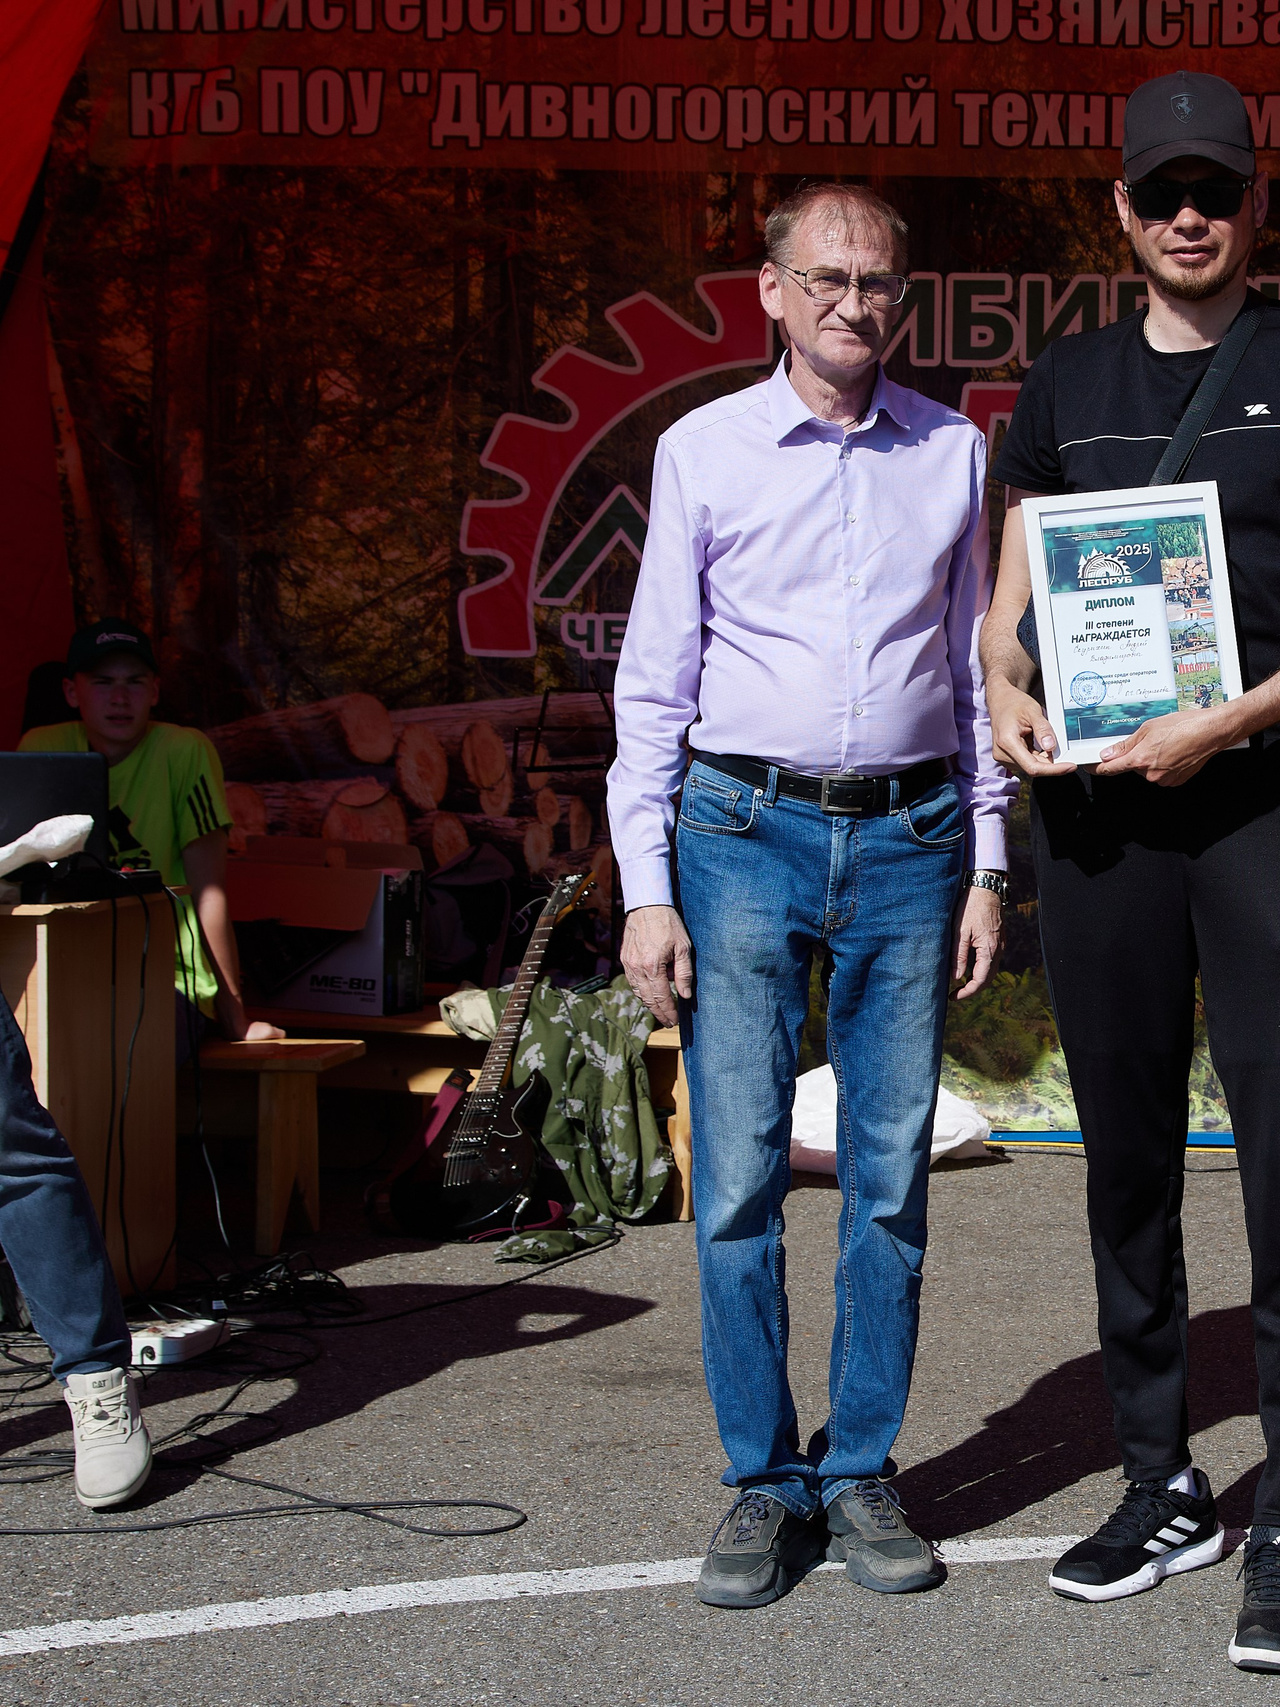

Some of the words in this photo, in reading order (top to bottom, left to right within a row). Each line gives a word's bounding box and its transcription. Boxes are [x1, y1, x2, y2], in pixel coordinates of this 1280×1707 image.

[637, 0, 919, 42] лесного
[127, 66, 242, 138] КГБ
[257, 65, 384, 138] ПОУ
[400, 67, 937, 150] "Дивногорский
[1116, 543, 1151, 557] 2025
[1078, 575, 1134, 589] ЛЕСОРУБ
[1085, 596, 1136, 612] ДИПЛОМ
[1085, 621, 1094, 630] III
[1096, 619, 1135, 629] степени
[1071, 628, 1151, 644] НАГРАЖДАЕТСЯ
[309, 974, 376, 991] ME-80
[91, 1378, 108, 1389] CAT
